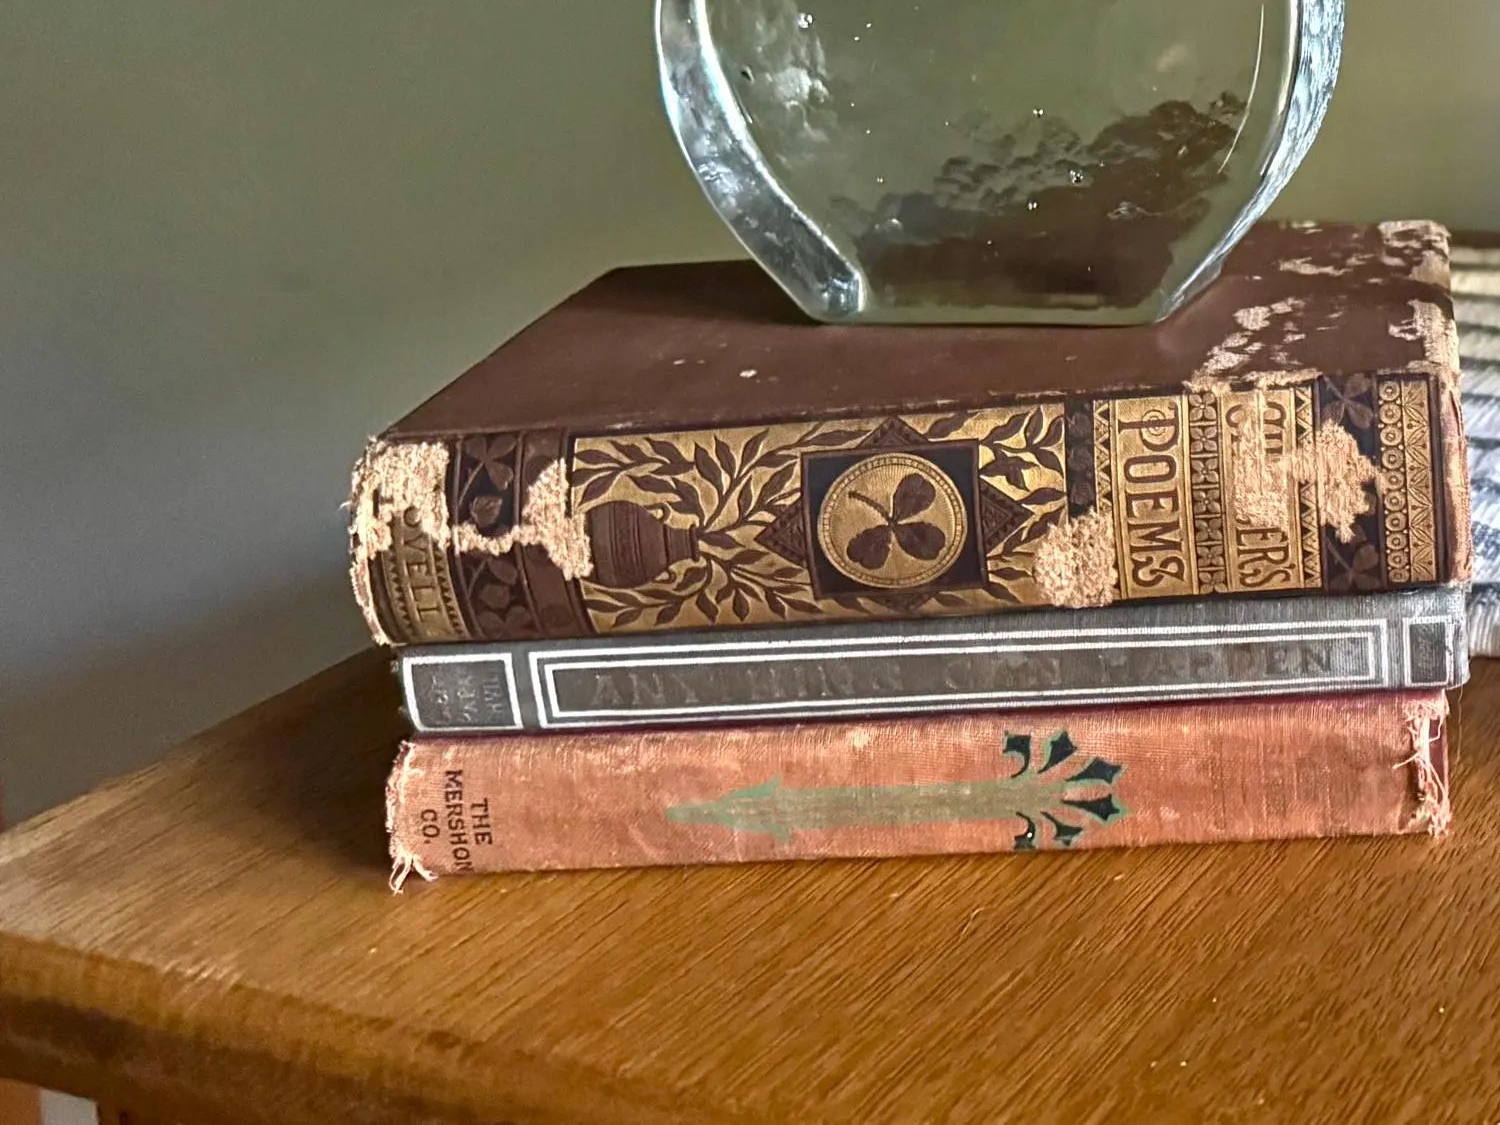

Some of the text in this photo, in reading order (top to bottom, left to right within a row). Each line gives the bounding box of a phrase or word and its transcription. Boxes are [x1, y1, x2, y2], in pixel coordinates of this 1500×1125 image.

[1117, 402, 1187, 589] POEMS
[403, 505, 440, 622] OVELL
[420, 808, 441, 844] CO.
[444, 769, 474, 873] MERSHON
[470, 797, 493, 846] THE
